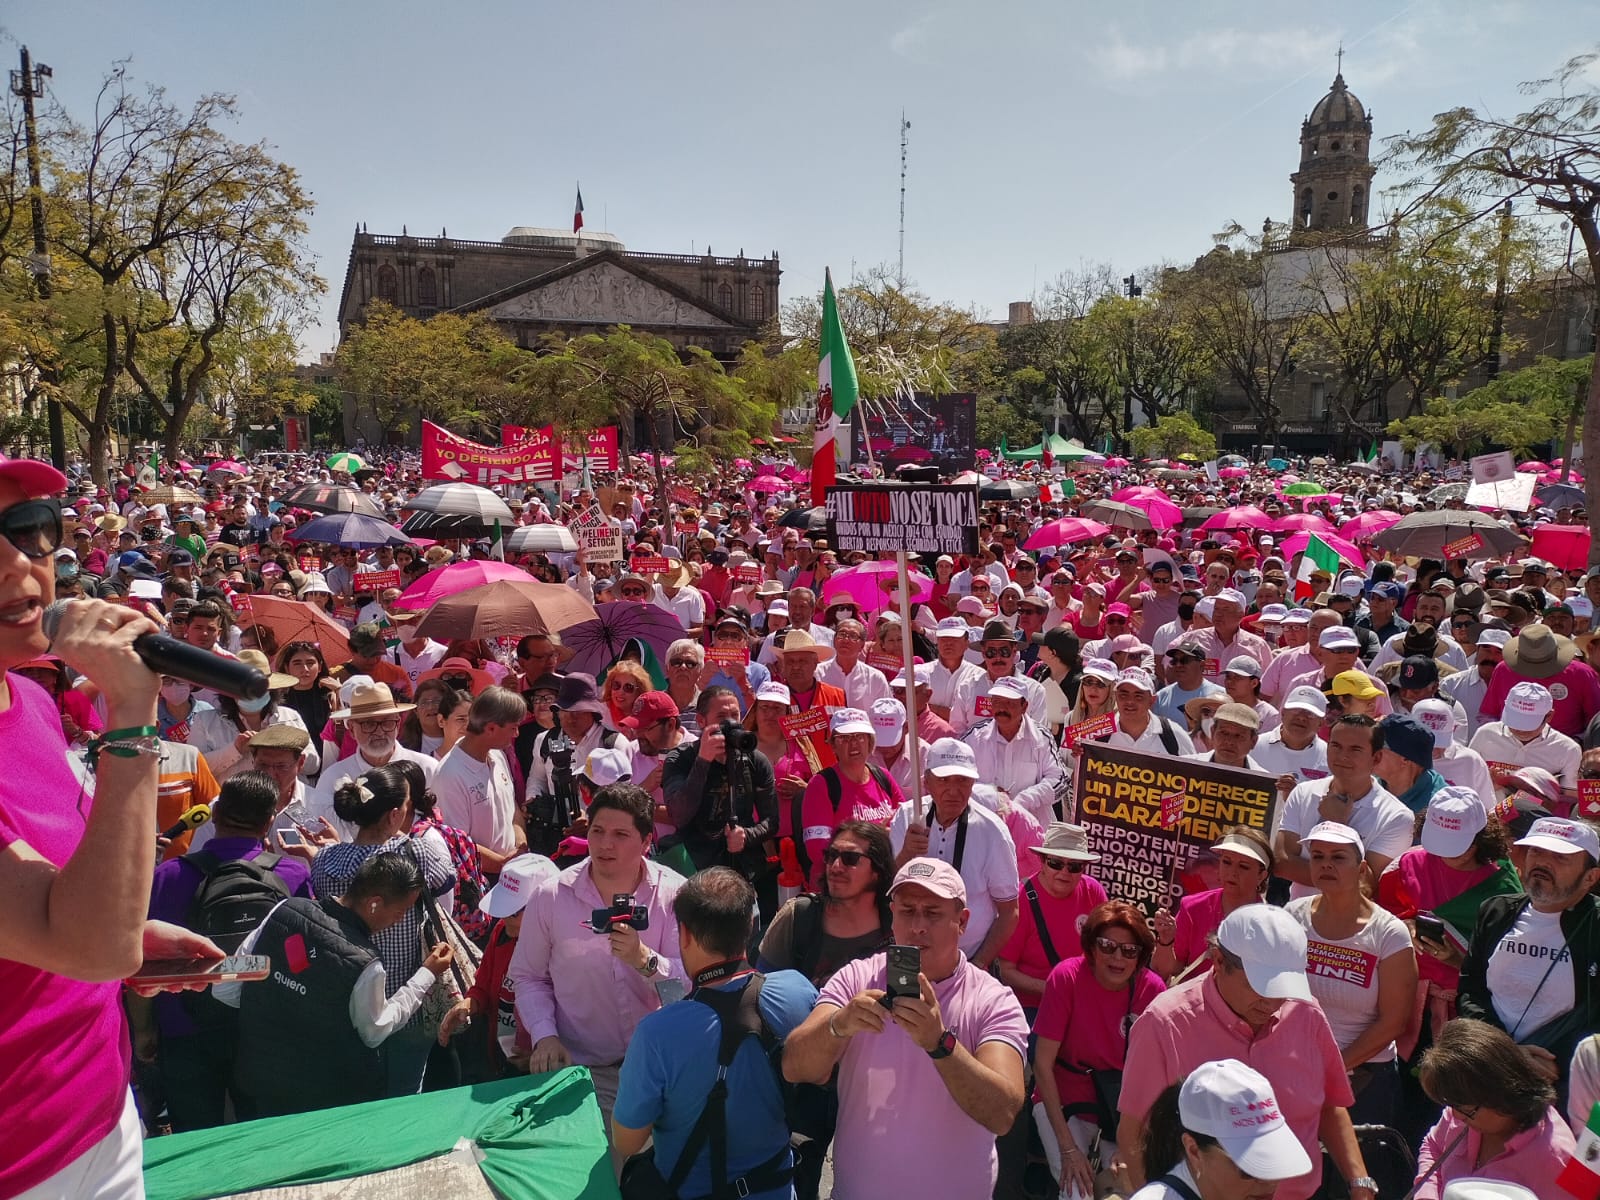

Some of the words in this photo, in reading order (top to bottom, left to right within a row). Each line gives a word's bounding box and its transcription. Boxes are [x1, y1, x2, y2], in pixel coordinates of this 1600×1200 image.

[436, 433, 454, 445] LA
[436, 448, 456, 460] YO
[459, 452, 531, 465] DEFIENDO
[533, 449, 552, 460] AL
[477, 461, 553, 483] INE
[583, 527, 620, 539] #ELINENO
[835, 522, 858, 536] UNIDOS
[858, 524, 871, 536] POR
[872, 524, 881, 537] UN
[921, 525, 934, 539] CON
[838, 536, 864, 550] LIBERTAD
[866, 537, 903, 551] RESPONSABLE
[905, 538, 938, 552] SEGURIDAD
[799, 720, 829, 736] INE
[1086, 758, 1155, 784] MéXICO
[1157, 773, 1187, 791] NO
[1188, 777, 1270, 807] MERECE
[1085, 779, 1111, 797] un
[1114, 781, 1266, 828] PREDENTE
[1082, 796, 1233, 841] CLARAMEN
[1080, 820, 1200, 859] PREPOTENTE
[1087, 836, 1187, 870] GNORANTE
[1088, 851, 1164, 879] OBARDE
[503, 881, 520, 893] UNE
[507, 875, 521, 885] INE
[1100, 880, 1173, 908] RRUPTO
[1307, 947, 1368, 966] DEMOCRACIA
[1316, 943, 1362, 958] DEFIENDO
[1499, 939, 1570, 963] TROOPER
[1307, 954, 1352, 969] DEFIENDO
[1353, 964, 1366, 974] AL
[274, 971, 307, 996] quiero
[697, 967, 725, 983] Canon
[1315, 963, 1366, 986] INE
[1257, 1098, 1275, 1111] INE
[1255, 1110, 1280, 1125] UNE
